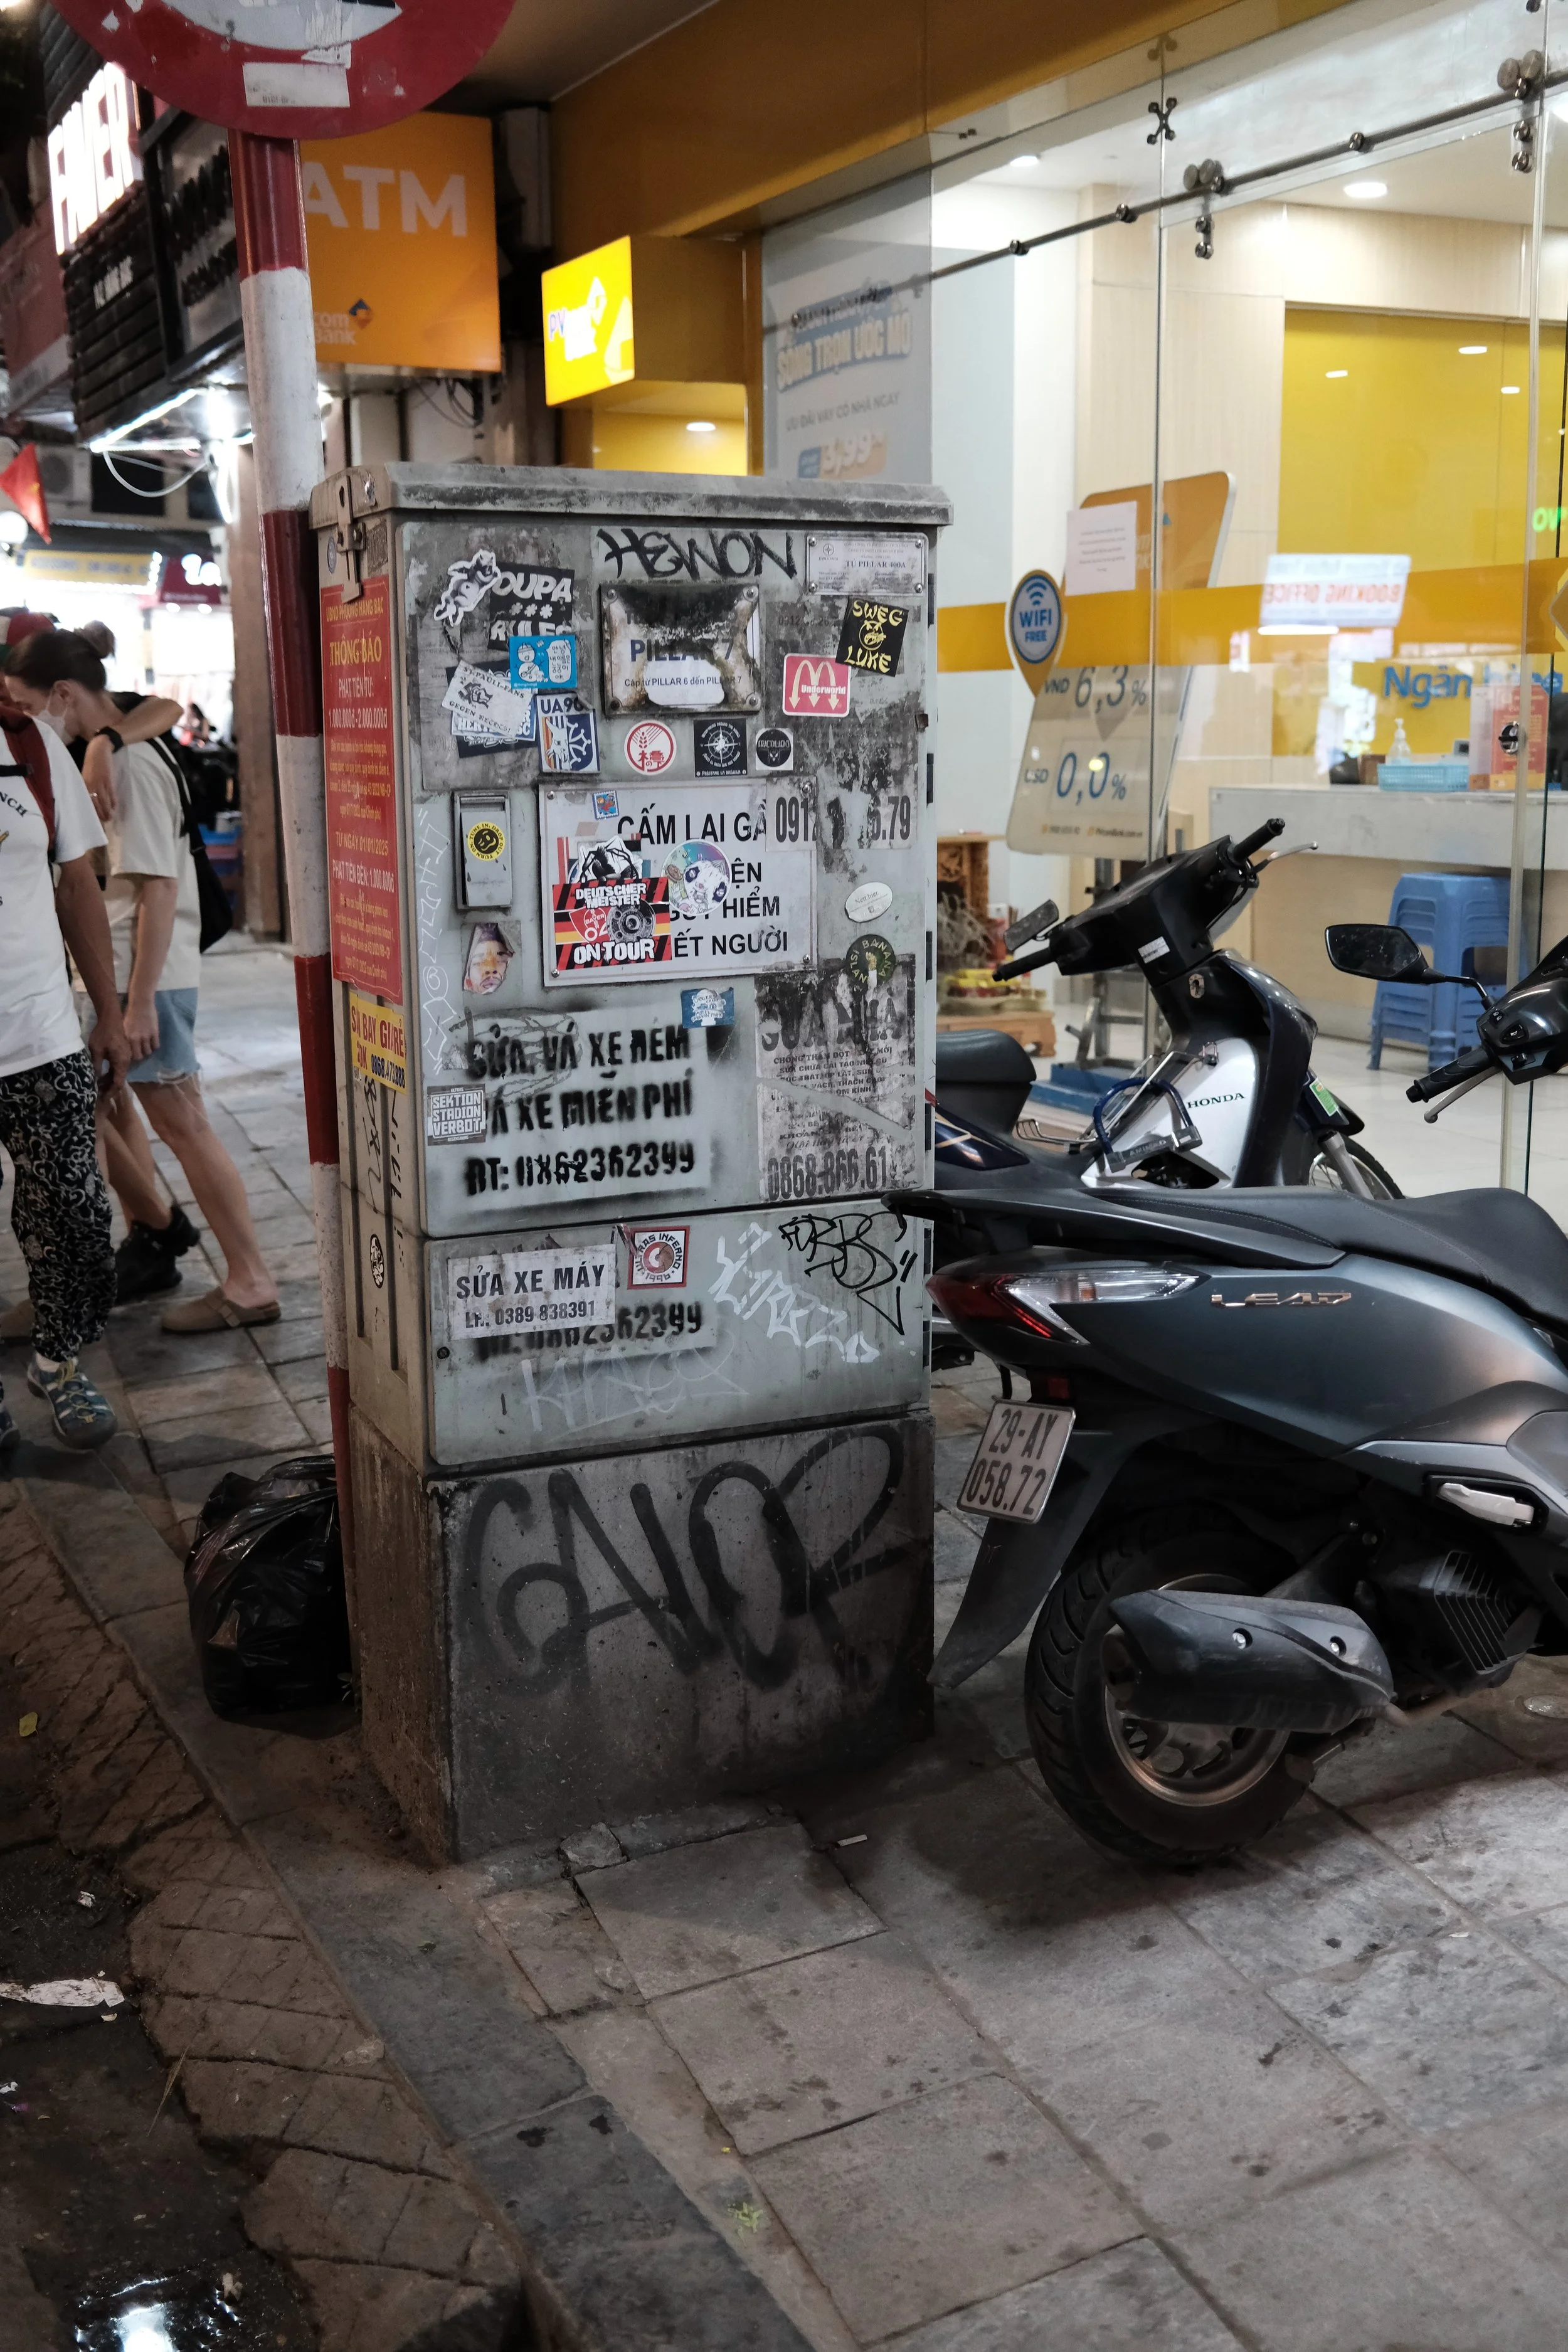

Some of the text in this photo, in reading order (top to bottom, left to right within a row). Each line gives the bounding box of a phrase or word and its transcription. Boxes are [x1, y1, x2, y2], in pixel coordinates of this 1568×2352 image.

[302, 161, 467, 237] ATM
[852, 600, 903, 627] SWEG
[1019, 608, 1052, 628] WIFI
[330, 629, 382, 666] THÔNG BÁO
[1025, 630, 1047, 643] FREE
[844, 645, 891, 674] LUKE
[625, 678, 640, 687] Cáp
[652, 677, 681, 686] PILLAR
[684, 677, 688, 686] 6
[690, 675, 704, 685] đến
[802, 684, 846, 694] Underworld
[1045, 677, 1070, 694] VND
[1383, 664, 1473, 709] Ngân
[449, 701, 476, 716] GEGEN
[575, 882, 647, 900] DEUTSCHER
[585, 893, 640, 909] MEISTER
[723, 886, 780, 918] HIỂM
[573, 938, 655, 965] ON TOUR
[712, 925, 788, 955] NGƯỜI
[850, 949, 869, 985] ISLAN
[861, 938, 892, 977] BANANA
[363, 1012, 376, 1045] BAY
[433, 1092, 481, 1109] SEKTION
[643, 1067, 692, 1120] PHÍ
[1187, 1091, 1246, 1109] HONDA
[433, 1105, 481, 1121] STADION
[433, 1118, 481, 1136] VERBOT
[659, 1232, 683, 1270] INFERNO
[457, 1261, 605, 1300] SỬA XE MÁY
[495, 1305, 534, 1326] 0389
[539, 1300, 595, 1321] 838391
[1210, 1292, 1352, 1308] LEAD
[988, 1408, 1058, 1460] 29-AY
[967, 1458, 1047, 1515] 058.72
